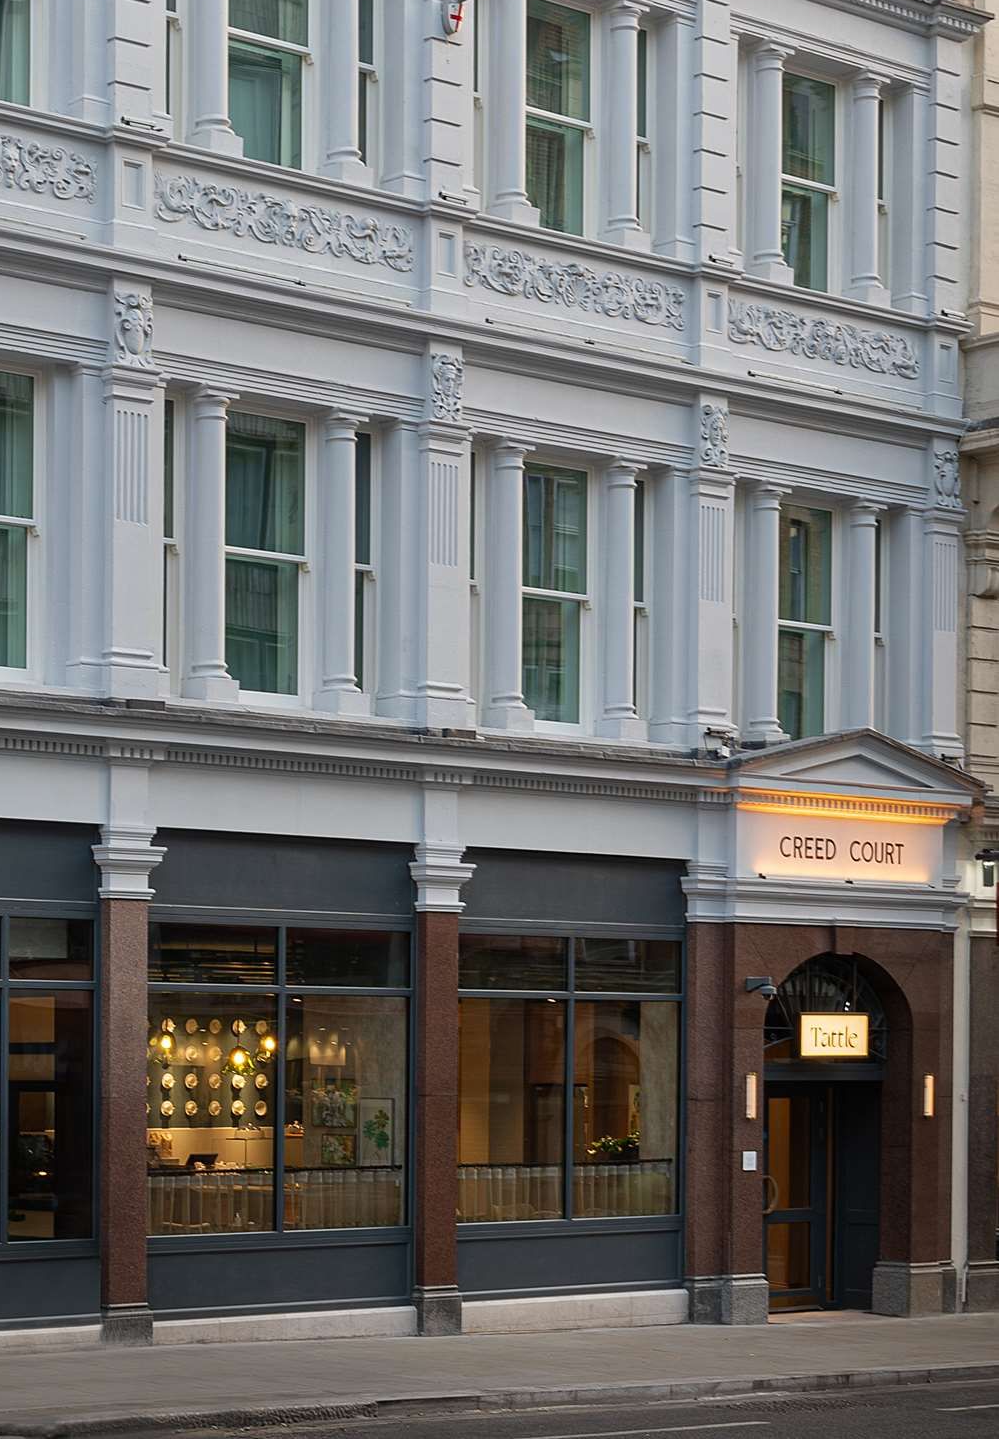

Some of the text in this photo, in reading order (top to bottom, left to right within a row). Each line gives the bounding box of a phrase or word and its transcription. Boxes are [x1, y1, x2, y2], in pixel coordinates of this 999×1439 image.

[779, 836, 905, 865] CREED COURT
[810, 1024, 859, 1049] Tattle
